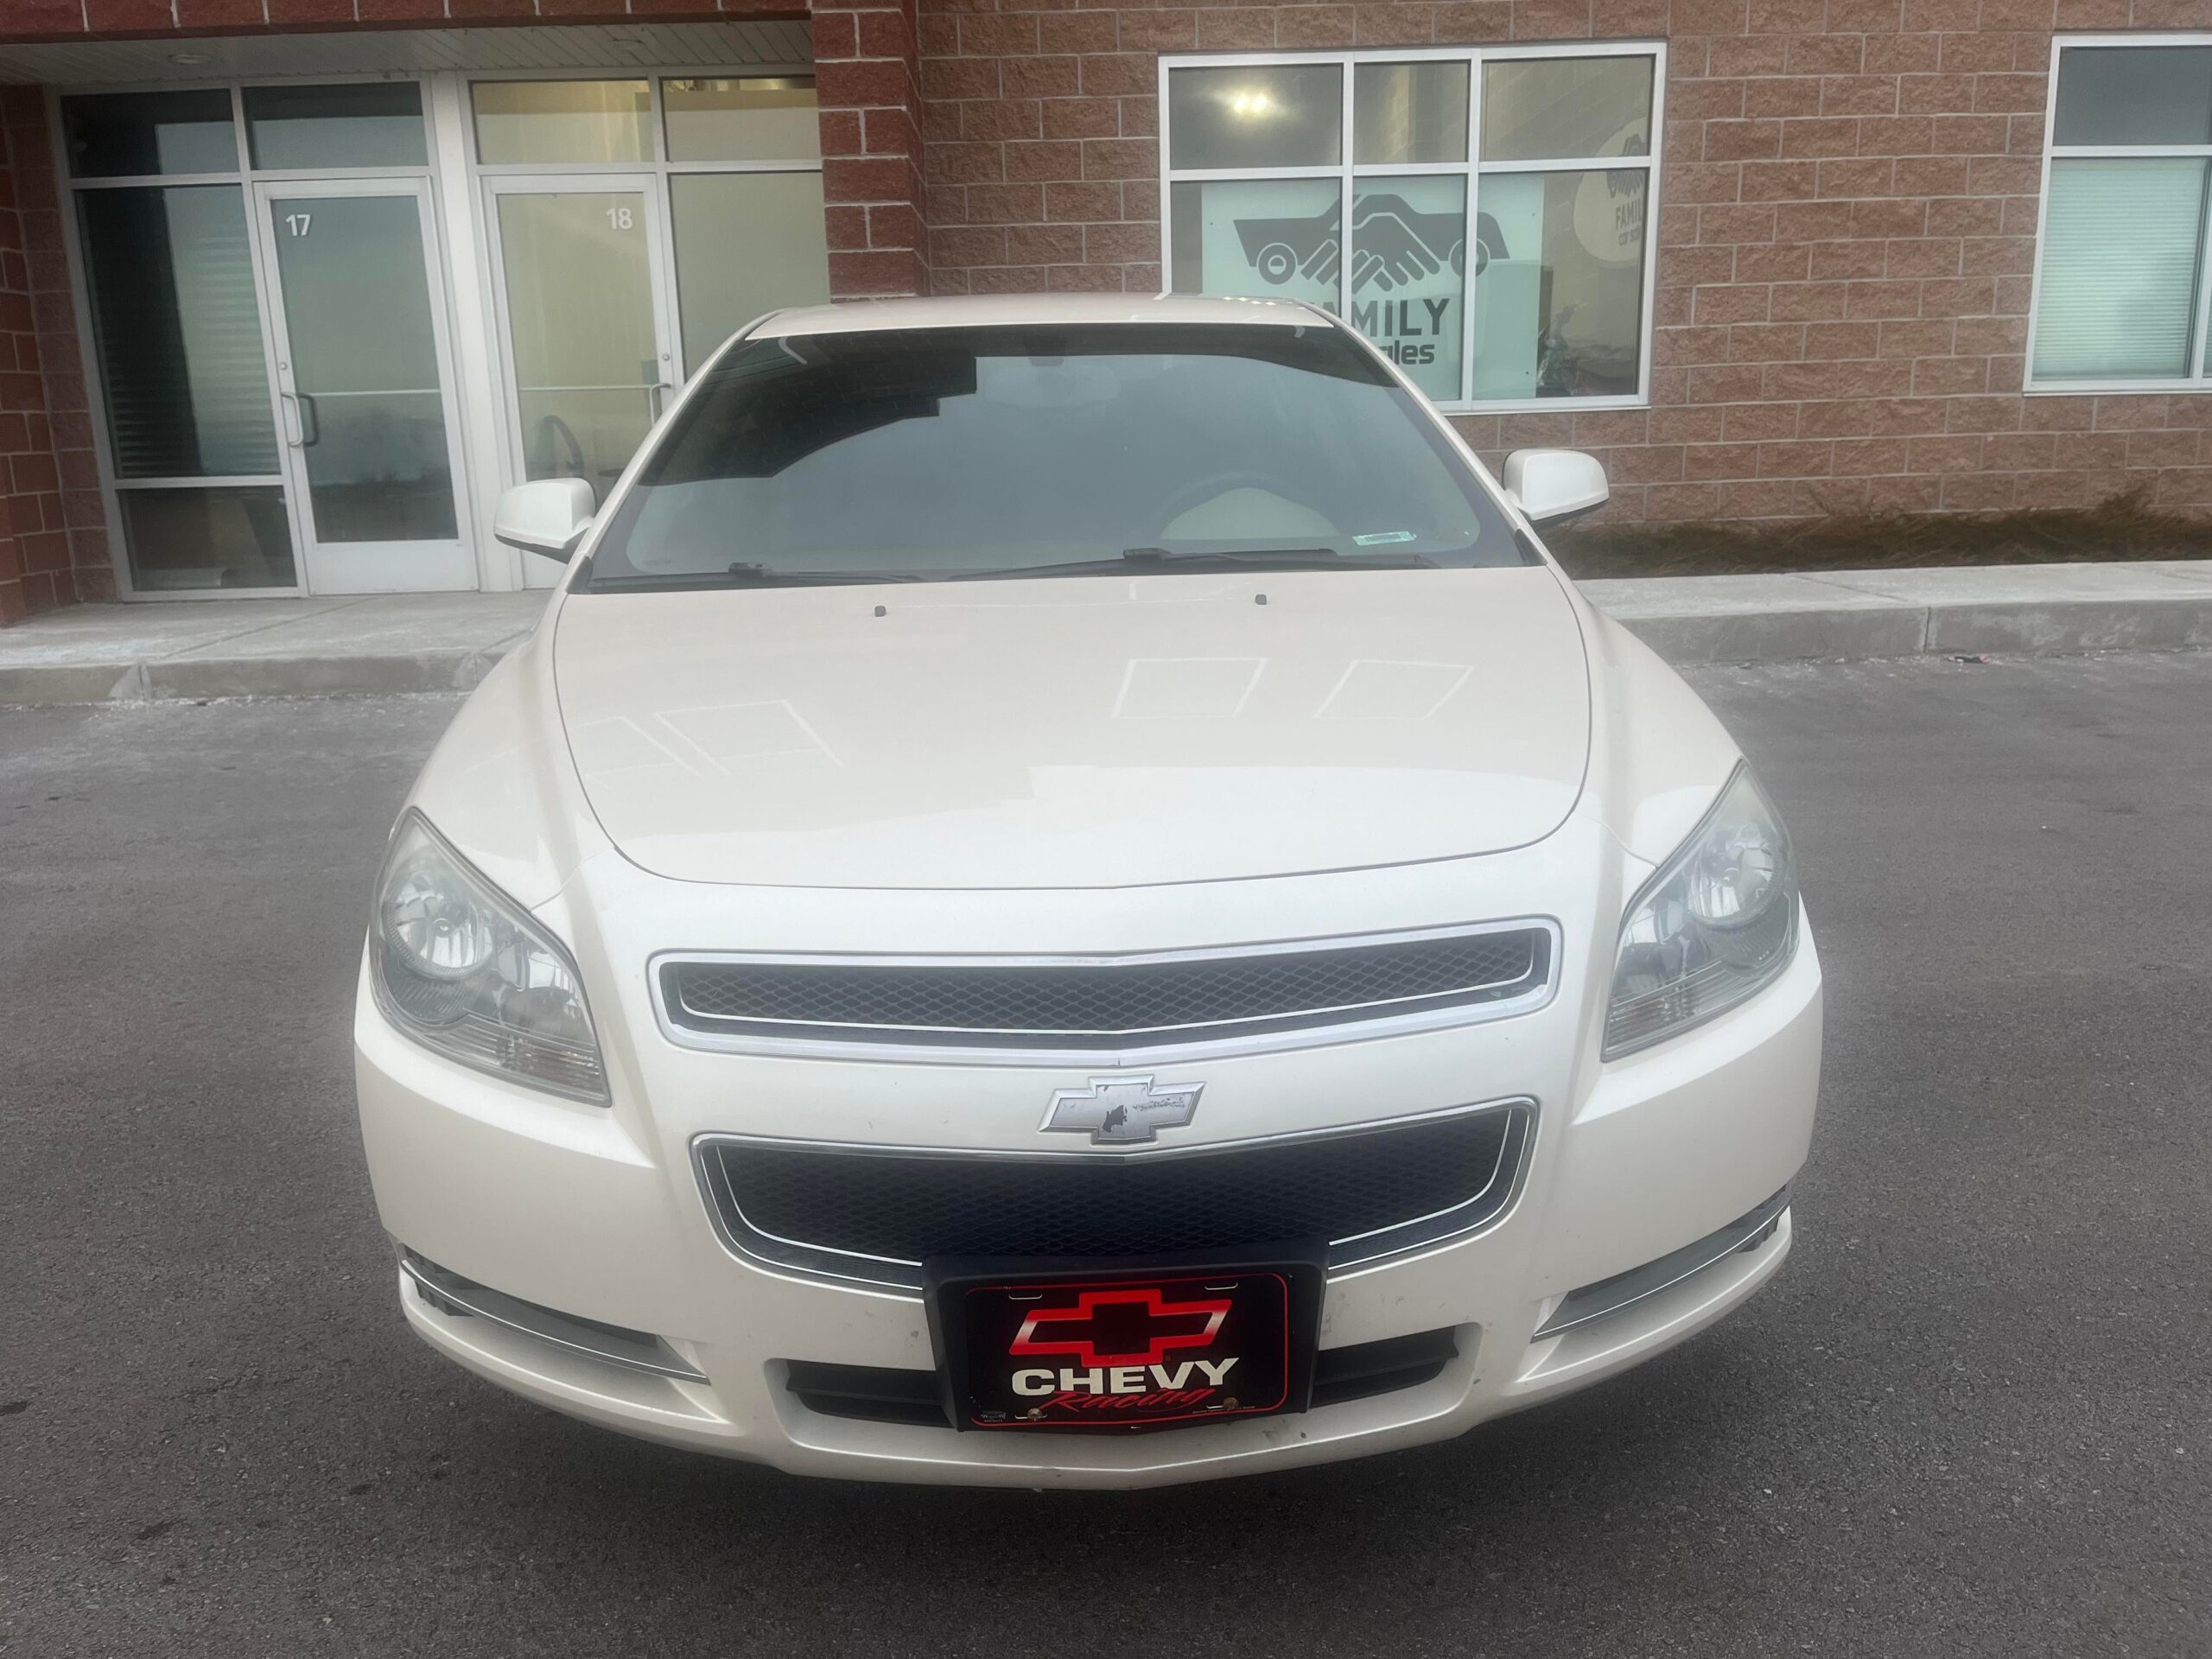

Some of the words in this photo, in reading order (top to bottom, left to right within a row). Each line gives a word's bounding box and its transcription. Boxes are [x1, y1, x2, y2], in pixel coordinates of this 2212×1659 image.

[285, 213, 311, 236] 17
[607, 207, 633, 230] 18
[1615, 198, 1643, 232] FAMIL
[1307, 298, 1451, 338] MILY
[1011, 1357, 1240, 1396] CHEVY
[1039, 1388, 1216, 1413] Racing
